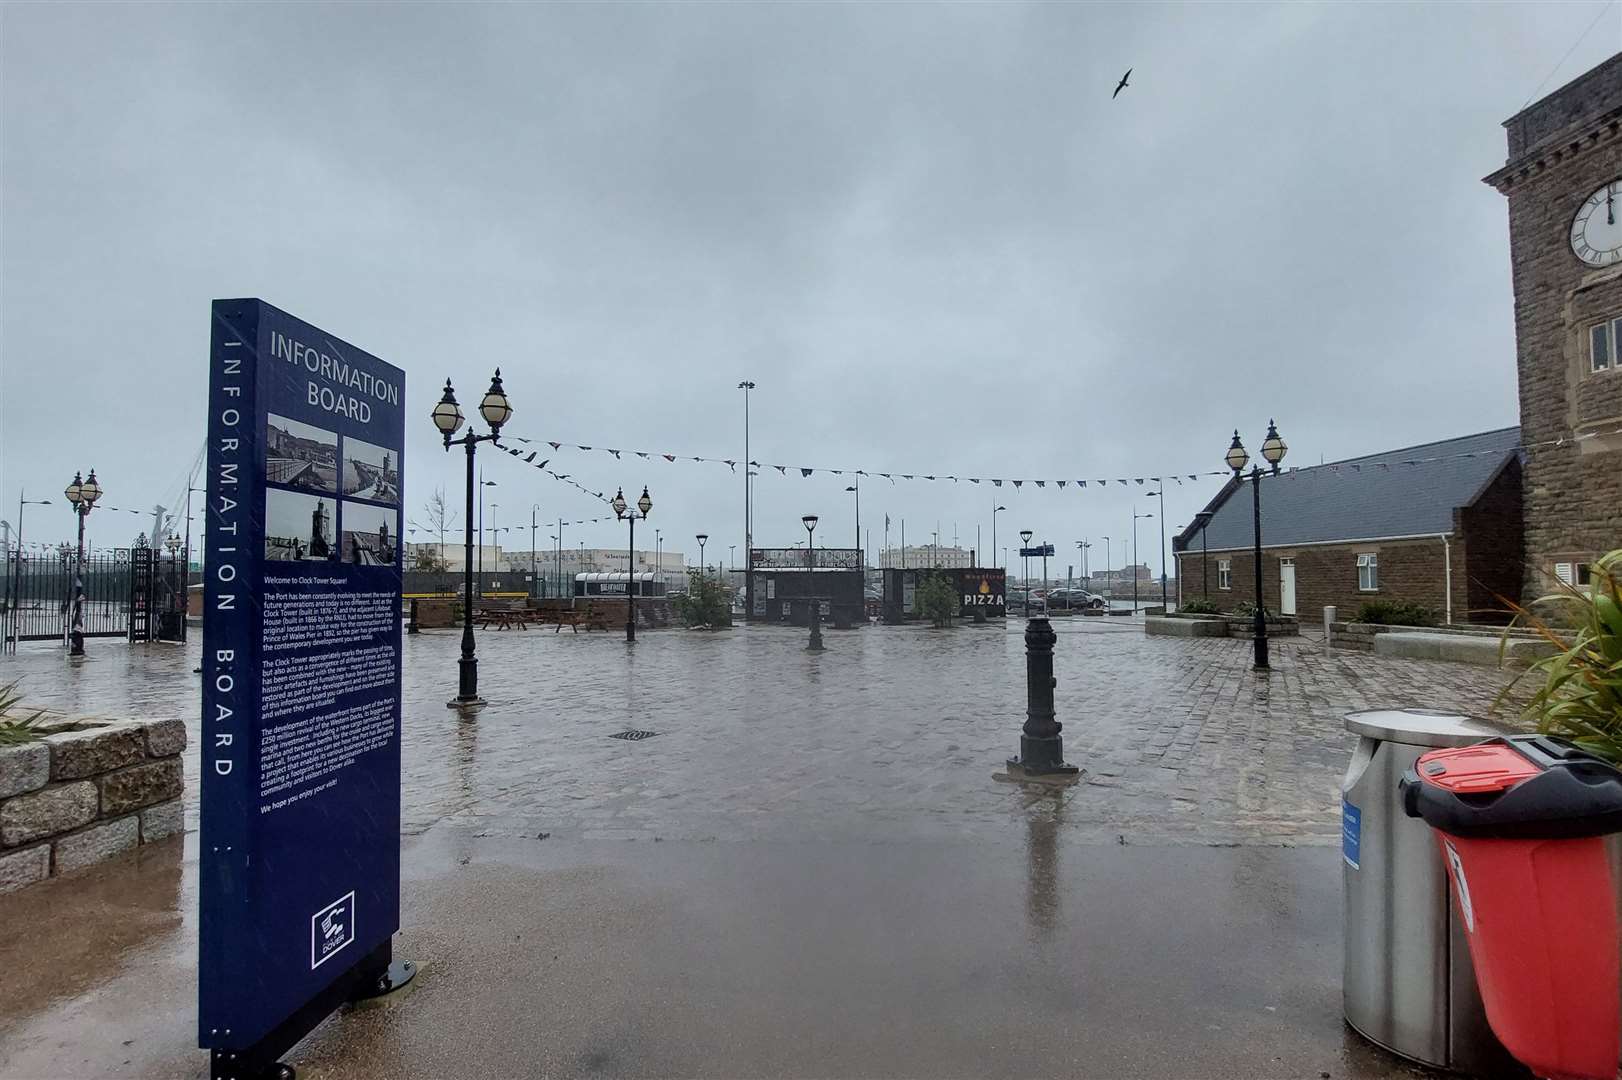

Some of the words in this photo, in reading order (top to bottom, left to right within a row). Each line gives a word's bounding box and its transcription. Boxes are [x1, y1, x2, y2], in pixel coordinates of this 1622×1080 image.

[270, 329, 398, 407] INFORMATION
[307, 379, 371, 425] BOARD
[217, 341, 242, 611] INFORMATION
[964, 595, 1004, 605] PIZZA
[262, 643, 273, 651] the
[261, 660, 274, 668] The
[261, 668, 273, 676] but
[261, 677, 272, 685] has
[214, 648, 236, 777] BOARD
[261, 710, 273, 719] and
[261, 727, 273, 736] The
[261, 734, 276, 745] £250
[260, 760, 274, 771] that
